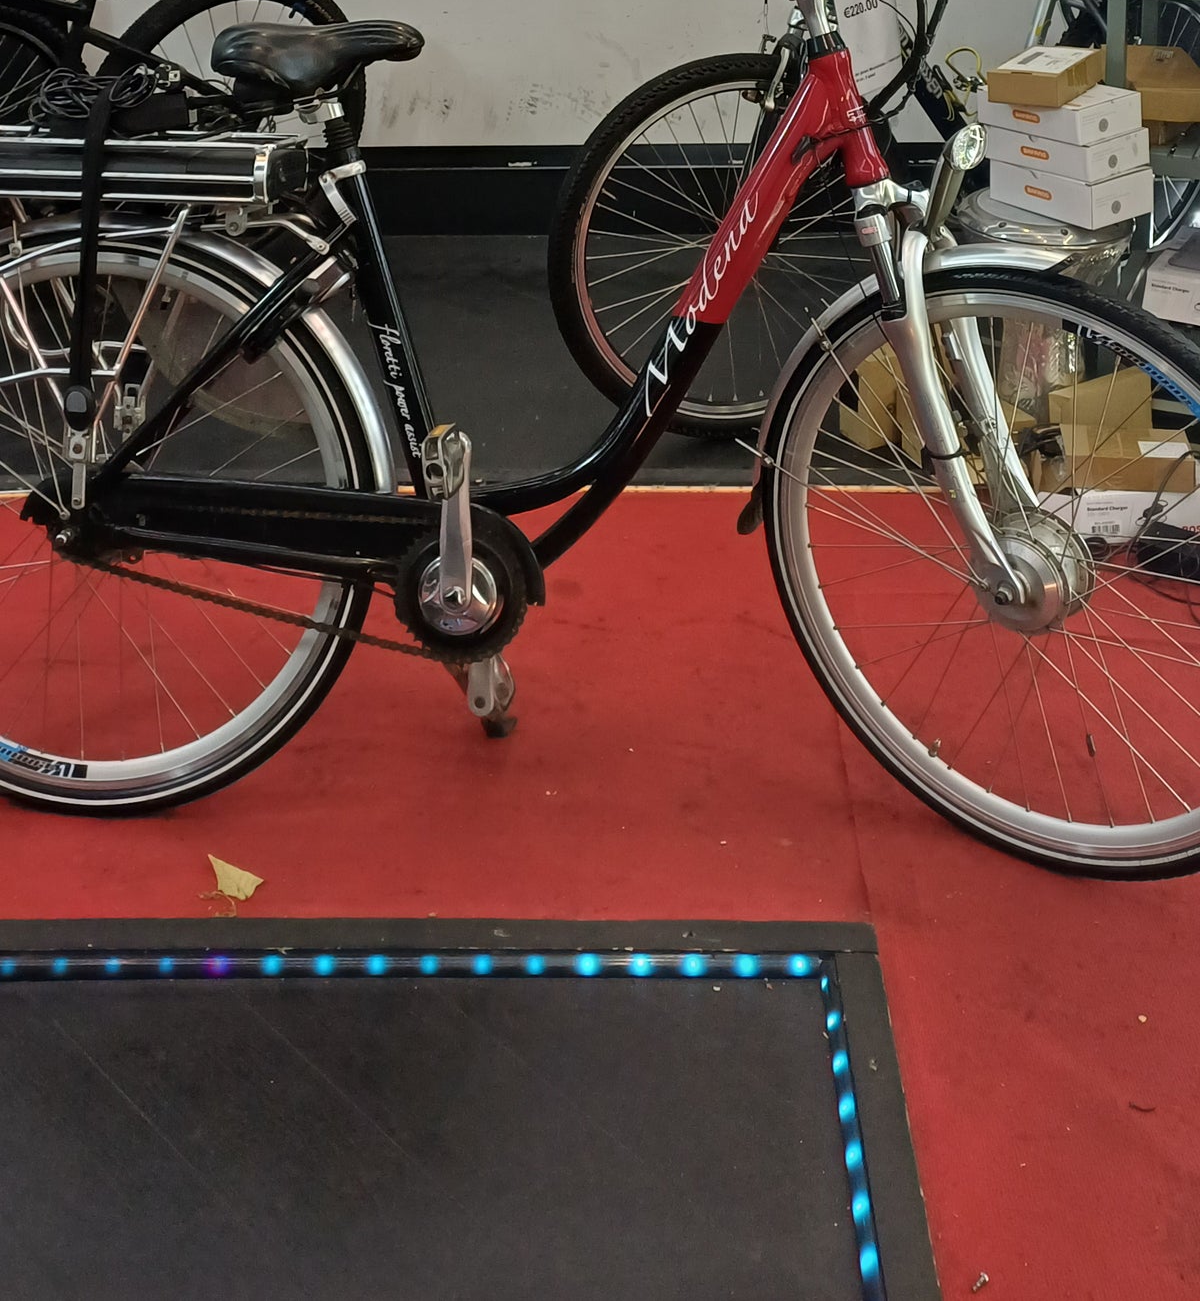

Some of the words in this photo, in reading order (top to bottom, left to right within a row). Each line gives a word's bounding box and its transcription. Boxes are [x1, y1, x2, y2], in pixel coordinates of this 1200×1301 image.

[644, 191, 759, 418] Modena
[383, 379, 411, 421] power
[404, 423, 422, 459] assist
